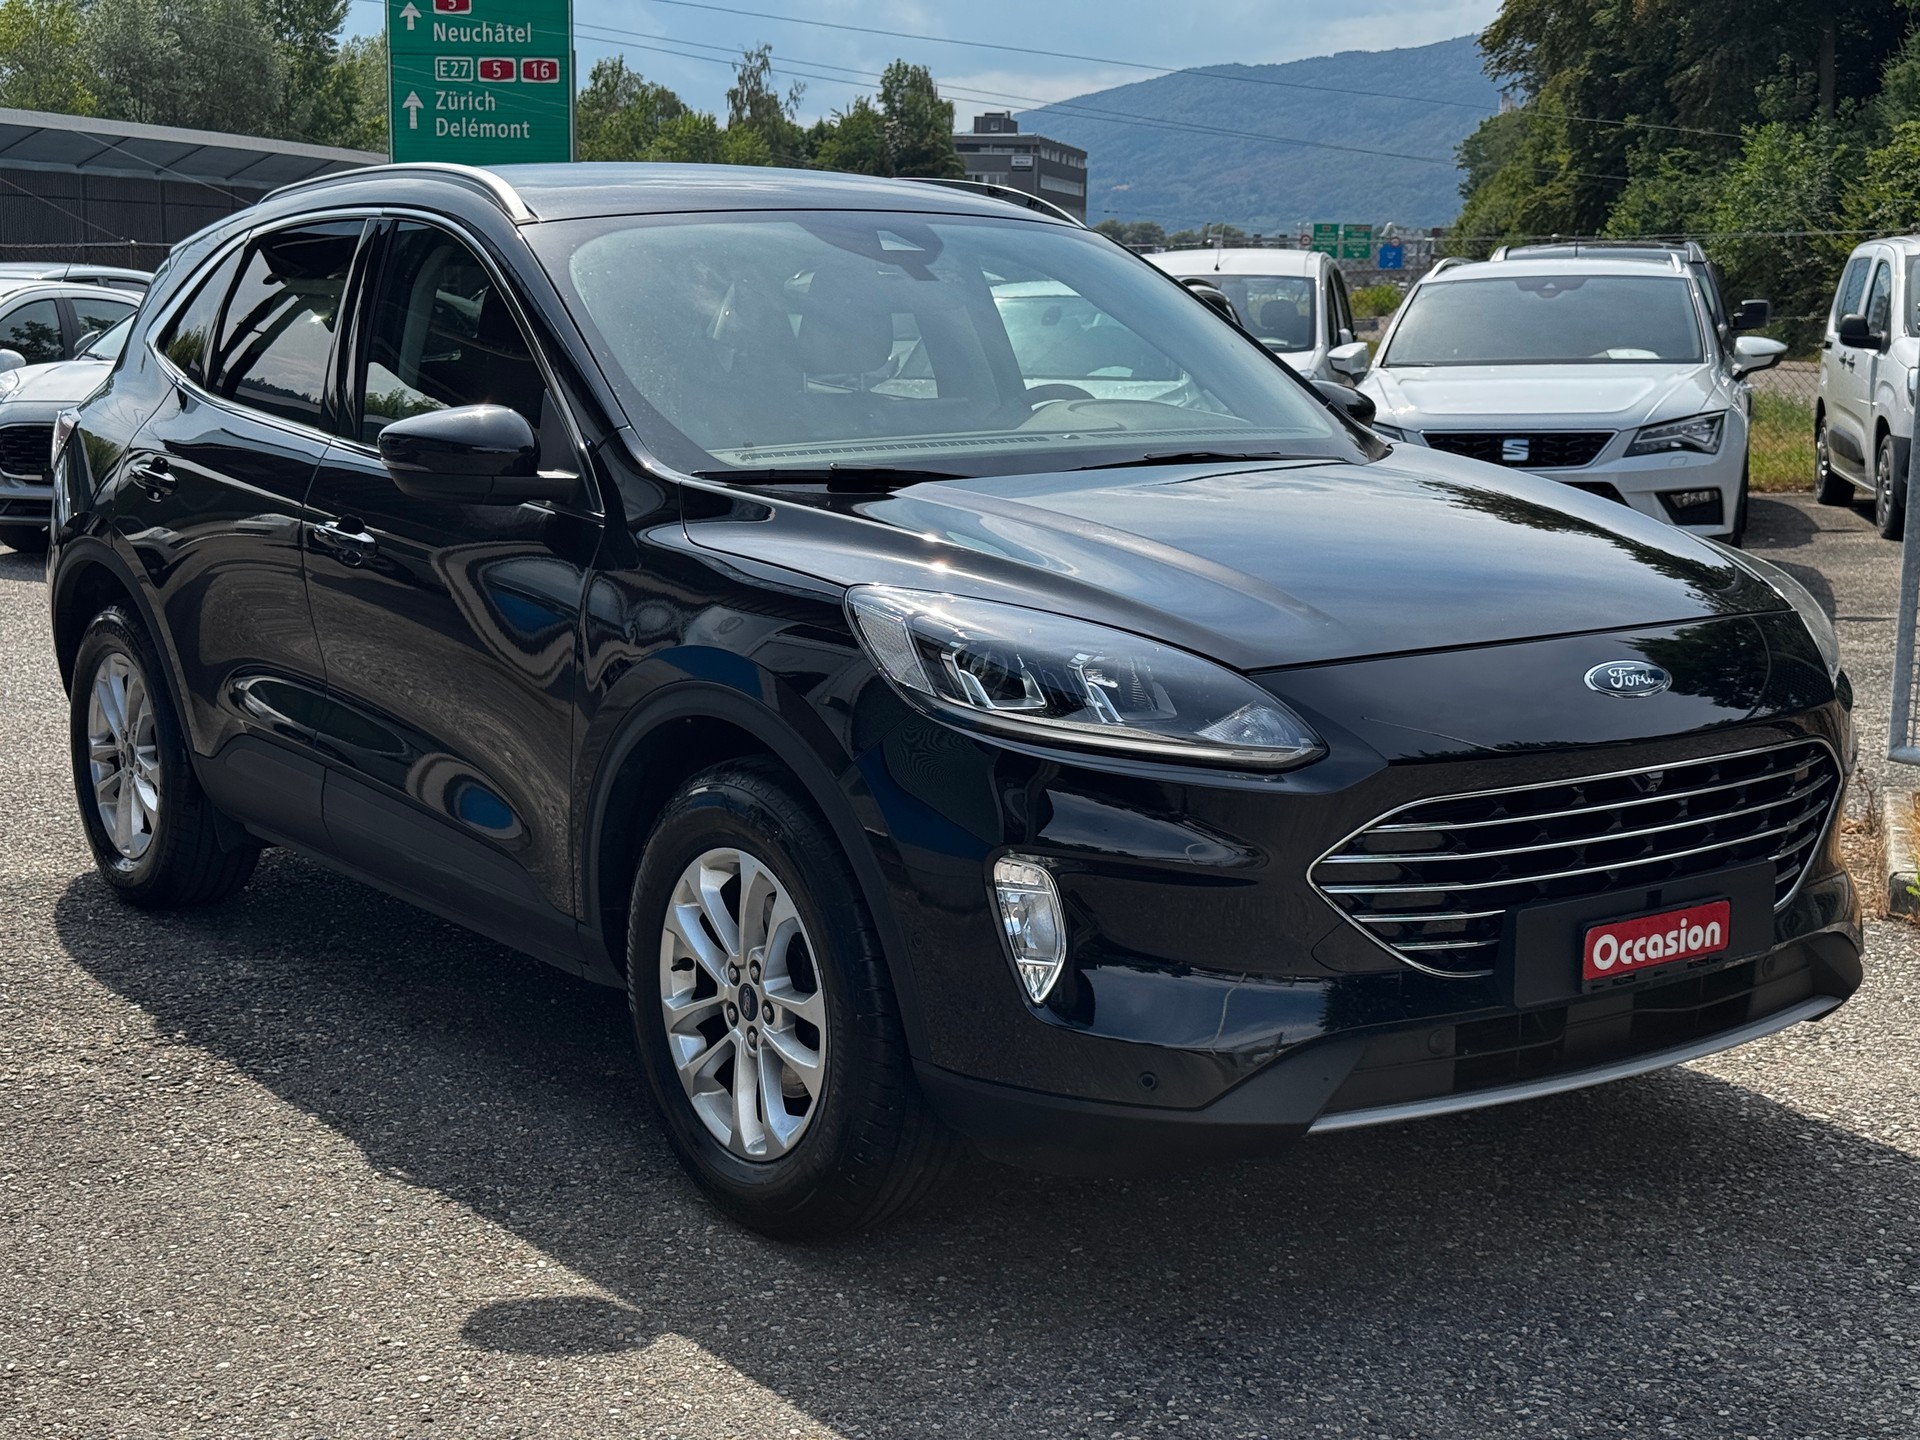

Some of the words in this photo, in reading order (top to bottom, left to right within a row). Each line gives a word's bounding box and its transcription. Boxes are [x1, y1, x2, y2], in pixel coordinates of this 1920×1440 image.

[433, 21, 532, 43] Neuchâtel
[439, 61, 469, 77] E27
[492, 61, 501, 78] 5
[531, 62, 550, 79] 16
[435, 91, 496, 111] Zürich
[435, 118, 530, 139] Delémont
[1608, 666, 1655, 688] Ford
[1592, 918, 1721, 970] Occasion
